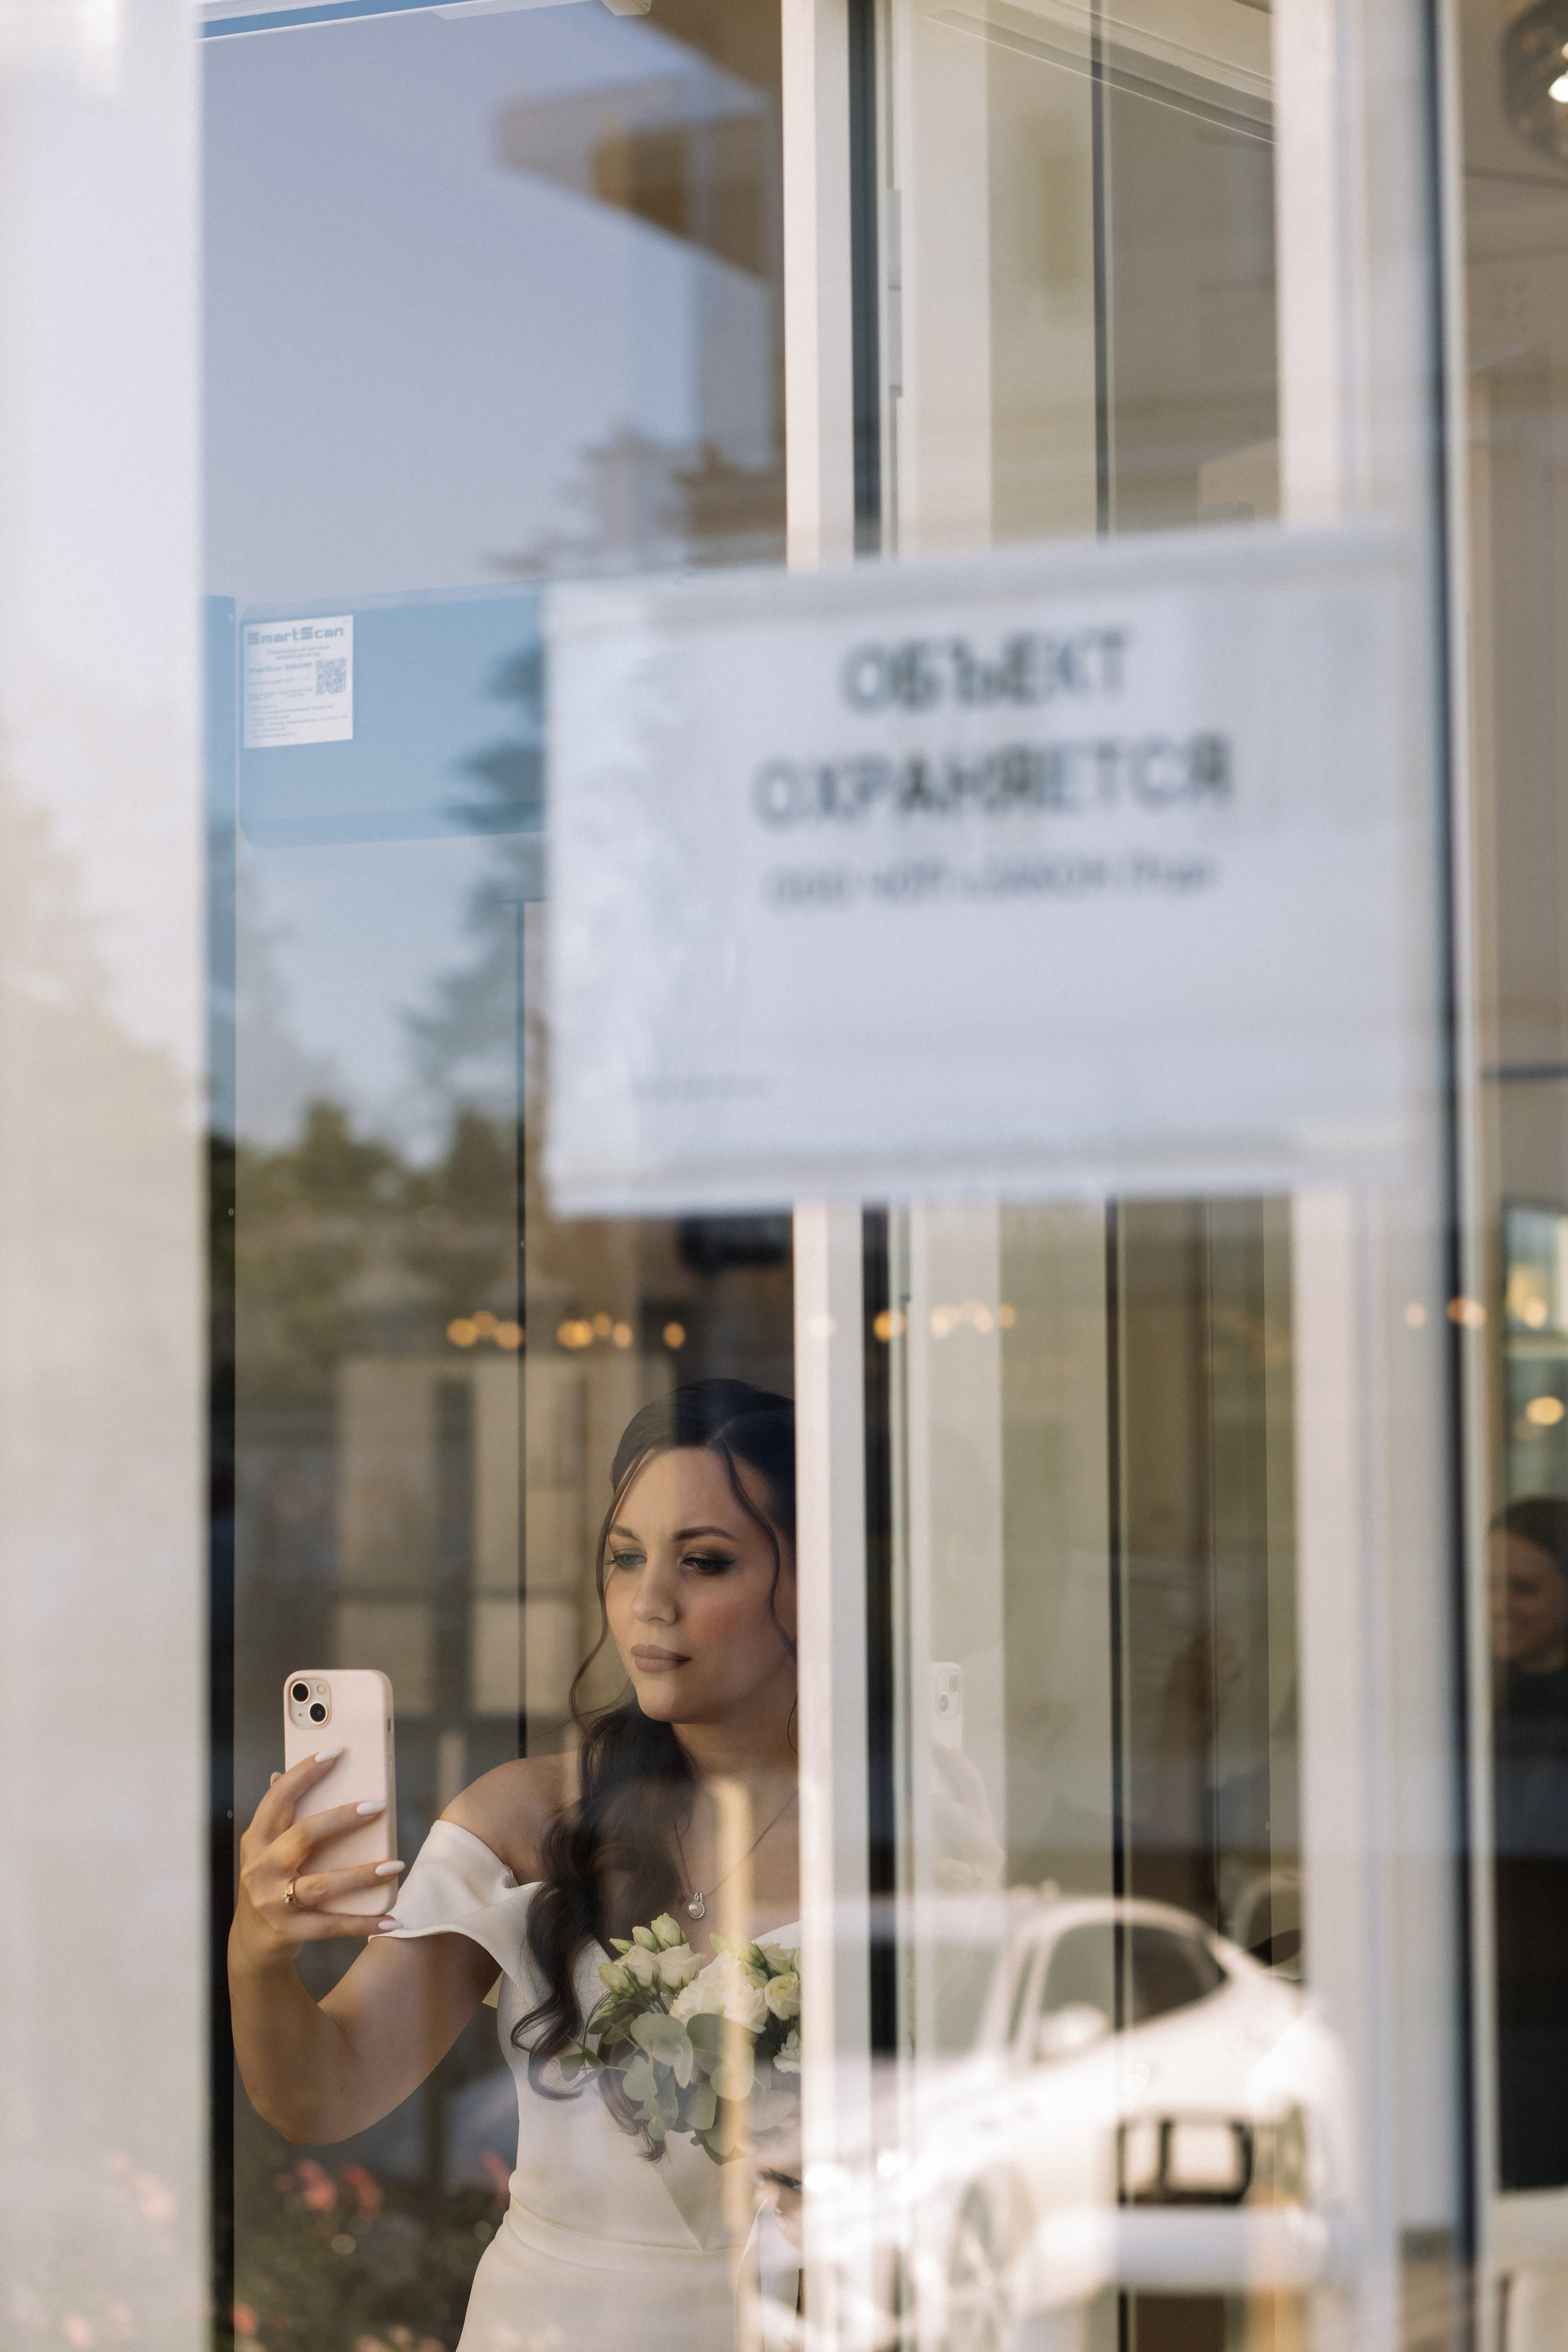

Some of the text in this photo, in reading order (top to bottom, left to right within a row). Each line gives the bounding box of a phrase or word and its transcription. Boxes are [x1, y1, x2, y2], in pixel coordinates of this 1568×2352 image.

[247, 627, 344, 645] SmartScan
[841, 626, 1131, 715] ОБЪЕКТ
[753, 734, 1234, 830] ОХРАНЯЕТСЯ
